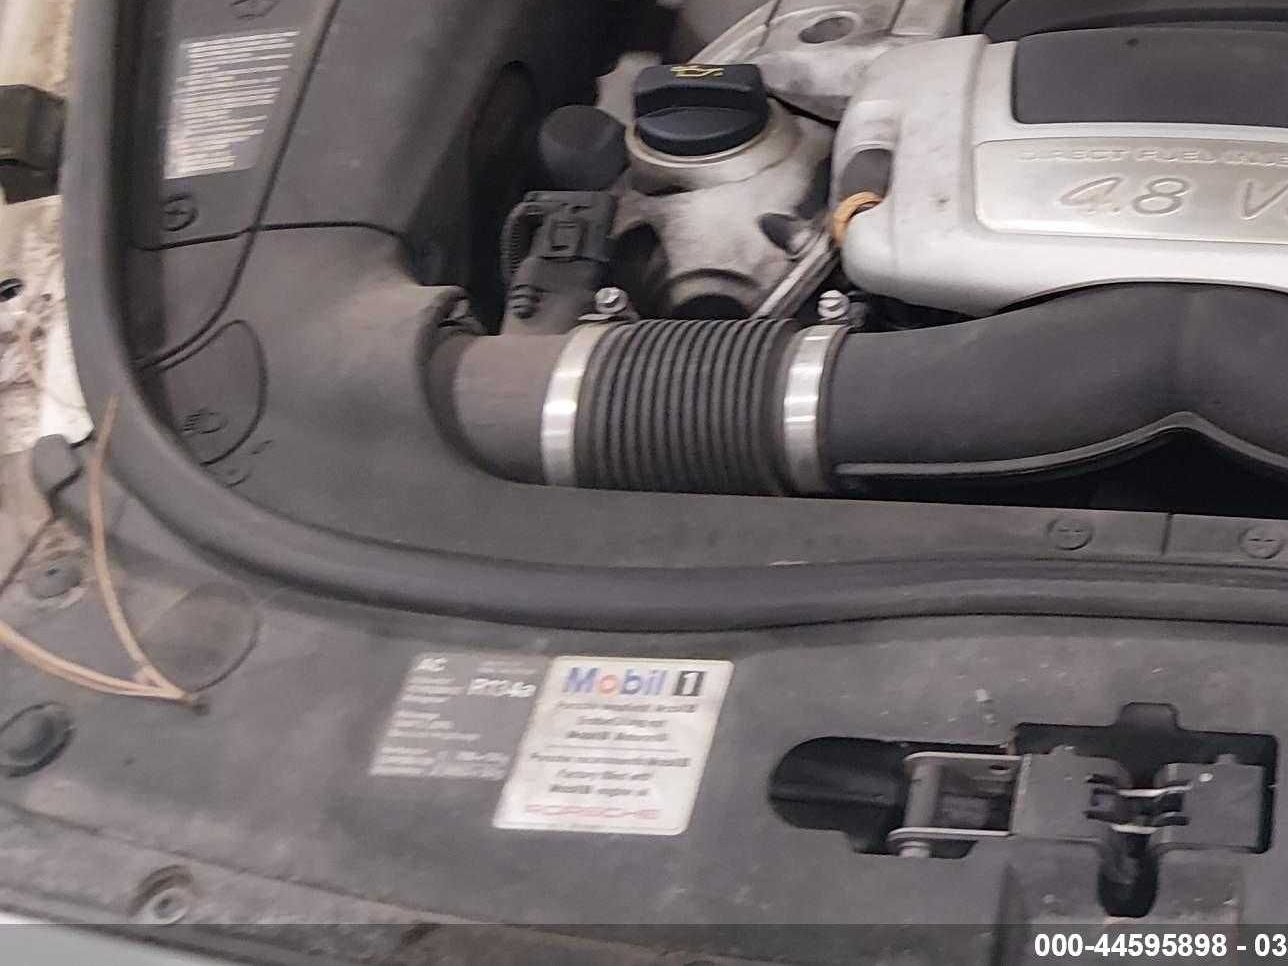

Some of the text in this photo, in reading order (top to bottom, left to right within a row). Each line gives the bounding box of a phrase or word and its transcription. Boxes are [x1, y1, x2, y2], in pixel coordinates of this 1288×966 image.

[1135, 148, 1217, 165] FUEL
[1058, 176, 1192, 216] 4.8
[562, 666, 668, 696] Mobil
[675, 670, 704, 696] 1
